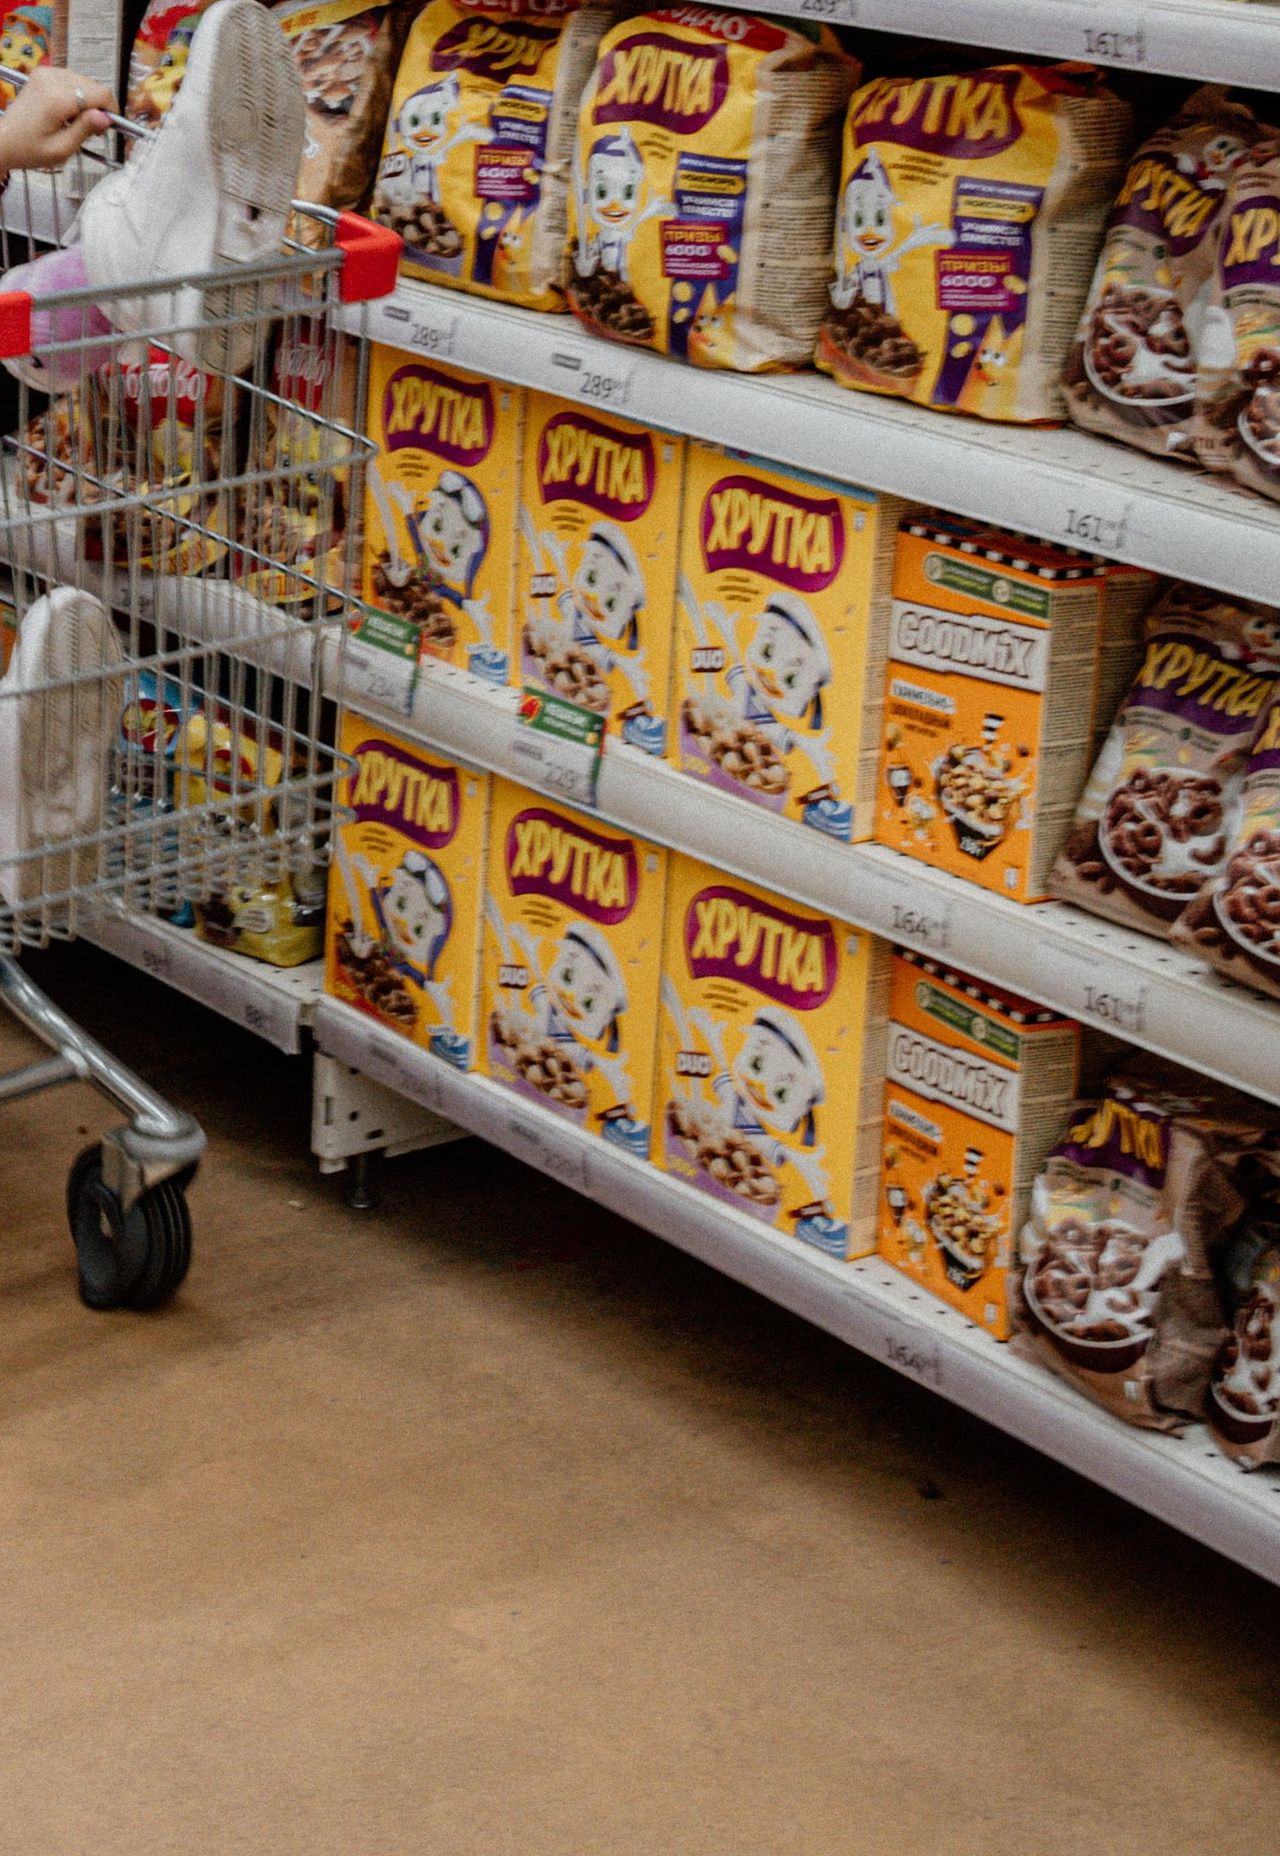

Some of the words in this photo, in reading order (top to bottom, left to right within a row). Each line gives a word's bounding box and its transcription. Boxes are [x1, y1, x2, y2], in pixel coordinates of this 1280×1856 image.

[664, 230, 724, 243] ПРИЗЫ
[664, 243, 712, 257] 6000
[940, 259, 1011, 274] ПРИЗЫ
[941, 274, 997, 288] 6000
[389, 376, 487, 449] ХРУТКА
[542, 424, 647, 503] ХРУТКА
[706, 487, 833, 575] ХРУТКА
[1133, 641, 1275, 717] ХРУТКА
[352, 750, 452, 833] ХРУТКА
[512, 819, 626, 908] ХРУТКА
[691, 896, 827, 993] ХРУТКА
[677, 1053, 712, 1076] DUO
